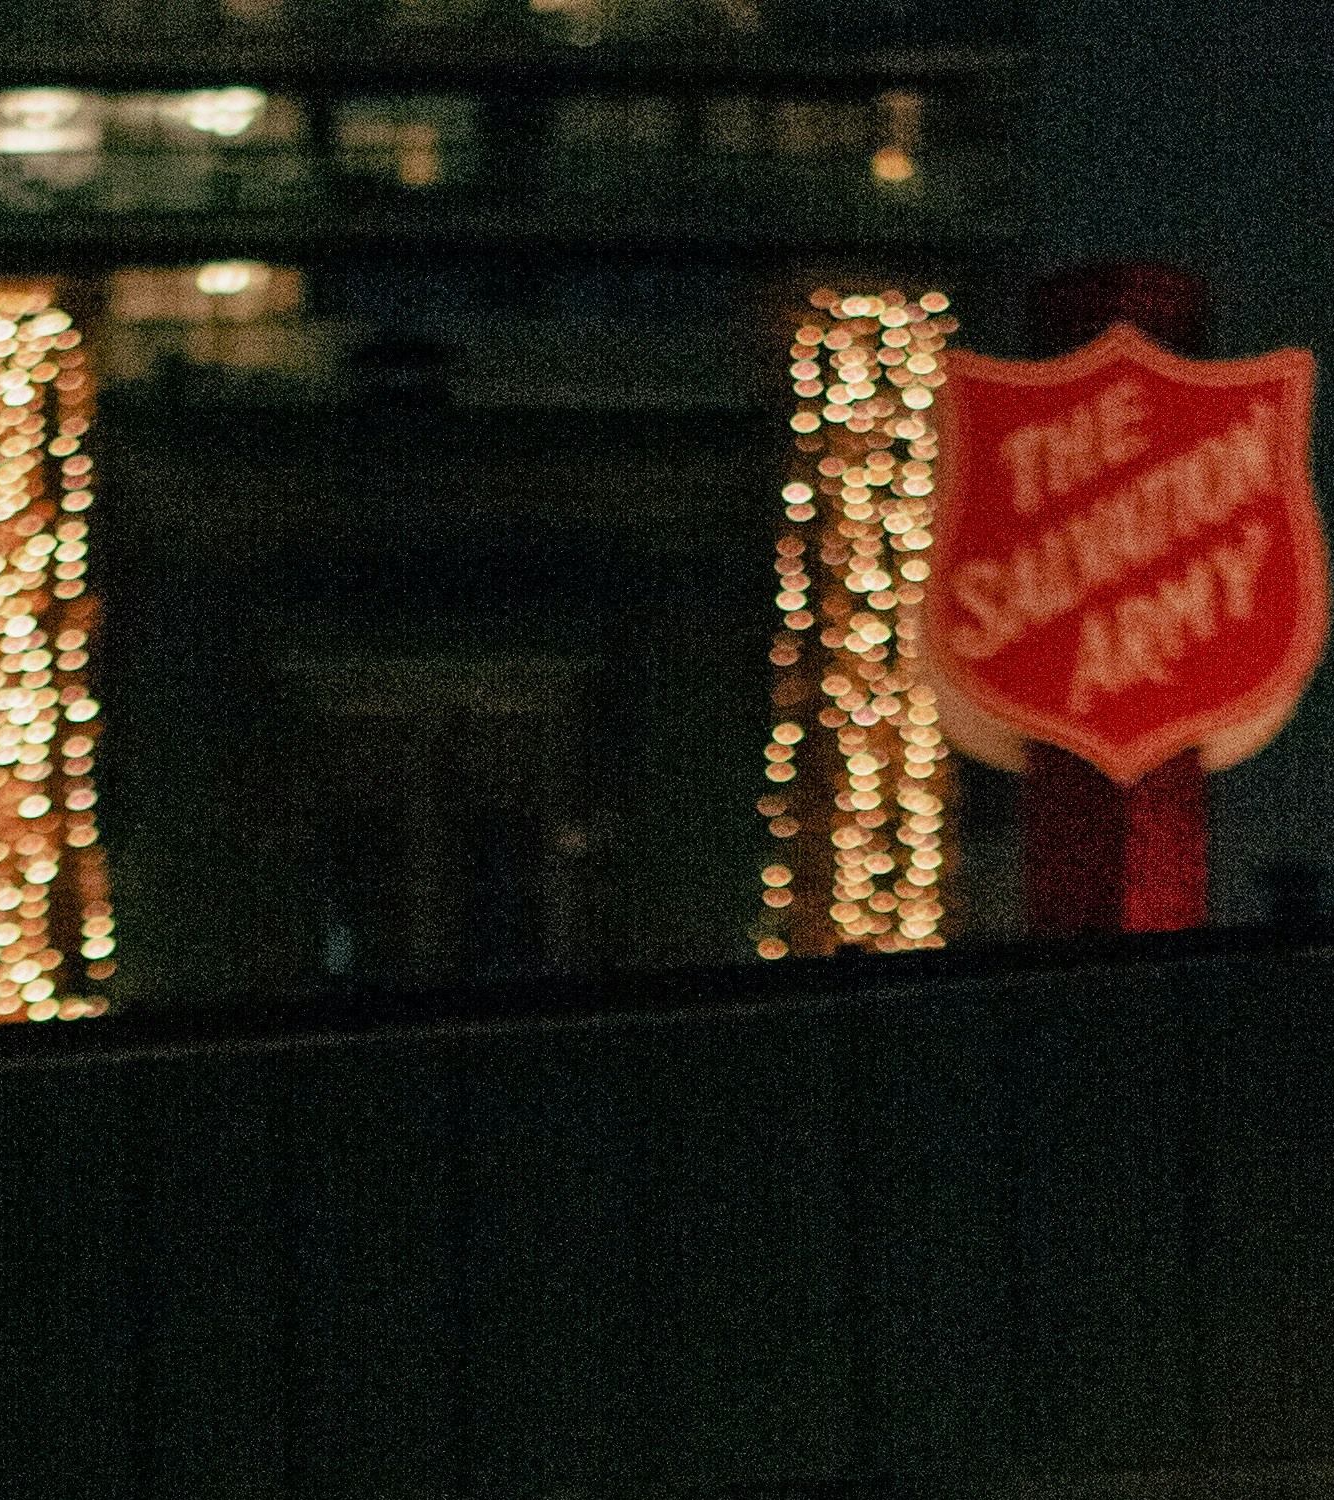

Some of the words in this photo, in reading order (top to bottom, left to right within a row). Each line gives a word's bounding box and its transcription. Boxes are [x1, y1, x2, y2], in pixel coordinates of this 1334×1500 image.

[948, 398, 1276, 660] SALVATION
[998, 377, 1151, 515] THE
[1065, 520, 1270, 716] ARMY
